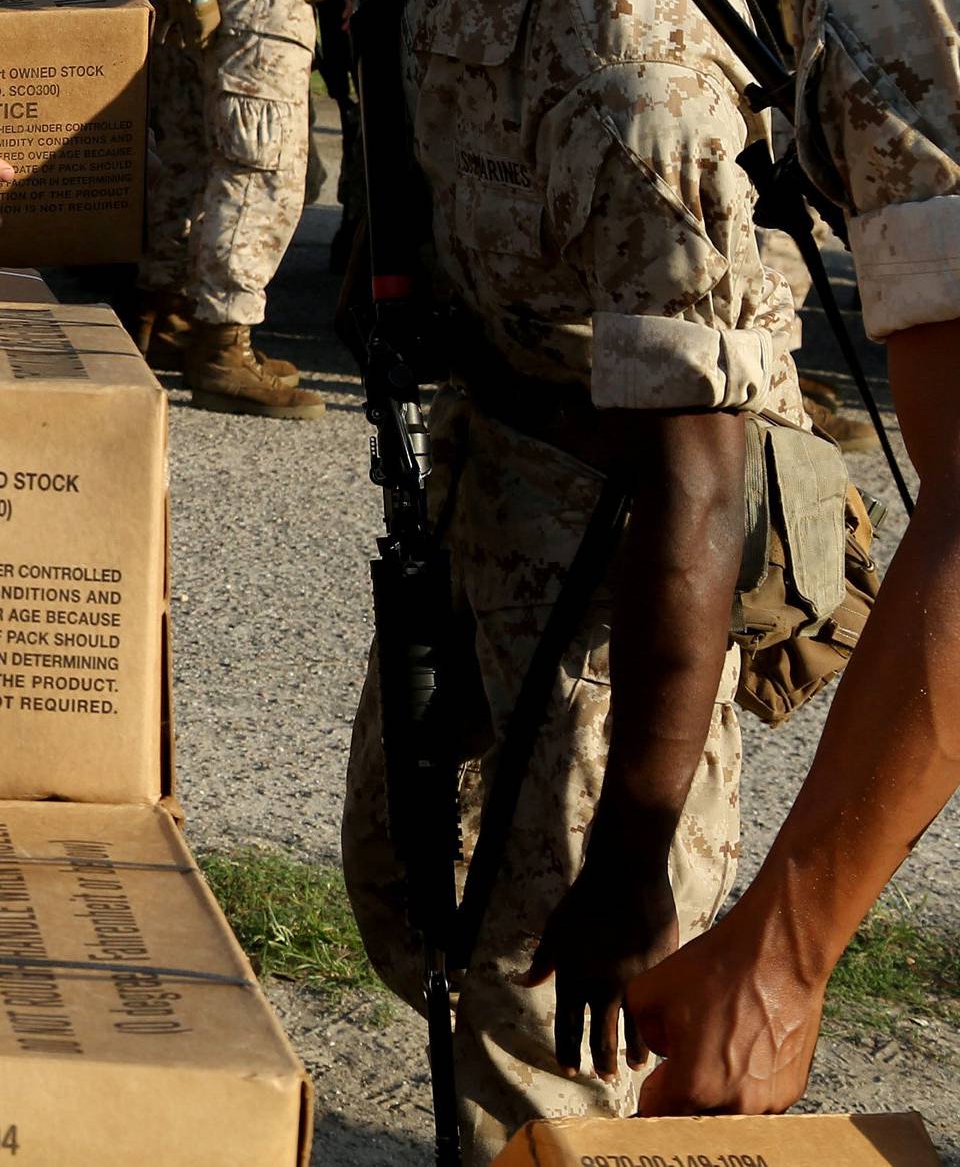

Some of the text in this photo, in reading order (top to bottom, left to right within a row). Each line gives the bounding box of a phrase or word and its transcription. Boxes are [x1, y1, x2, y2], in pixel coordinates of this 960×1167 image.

[8, 65, 57, 81] OWNED
[60, 63, 104, 79] STOCK
[8, 83, 60, 98] SCO300)
[27, 123, 63, 133] UNDER
[65, 120, 133, 132] CONTROLLED
[38, 134, 107, 146] CONDITIONS
[28, 151, 56, 161] OVER
[12, 471, 79, 493] STOCK
[17, 564, 122, 583] CONTROLLED
[85, 589, 121, 605] AND
[7, 608, 41, 623] AGE
[45, 609, 121, 627] BECAUSE
[6, 629, 49, 646] PACK
[53, 632, 120, 649] SHOULD
[11, 651, 118, 671] DETERMINING
[31, 675, 118, 692] PRODUCT.
[20, 696, 118, 714] REQUIRED.
[77, 877, 123, 891] or
[69, 893, 151, 961] Fahrenheit
[109, 969, 182, 1017] degree
[6, 1010, 76, 1037] NOT
